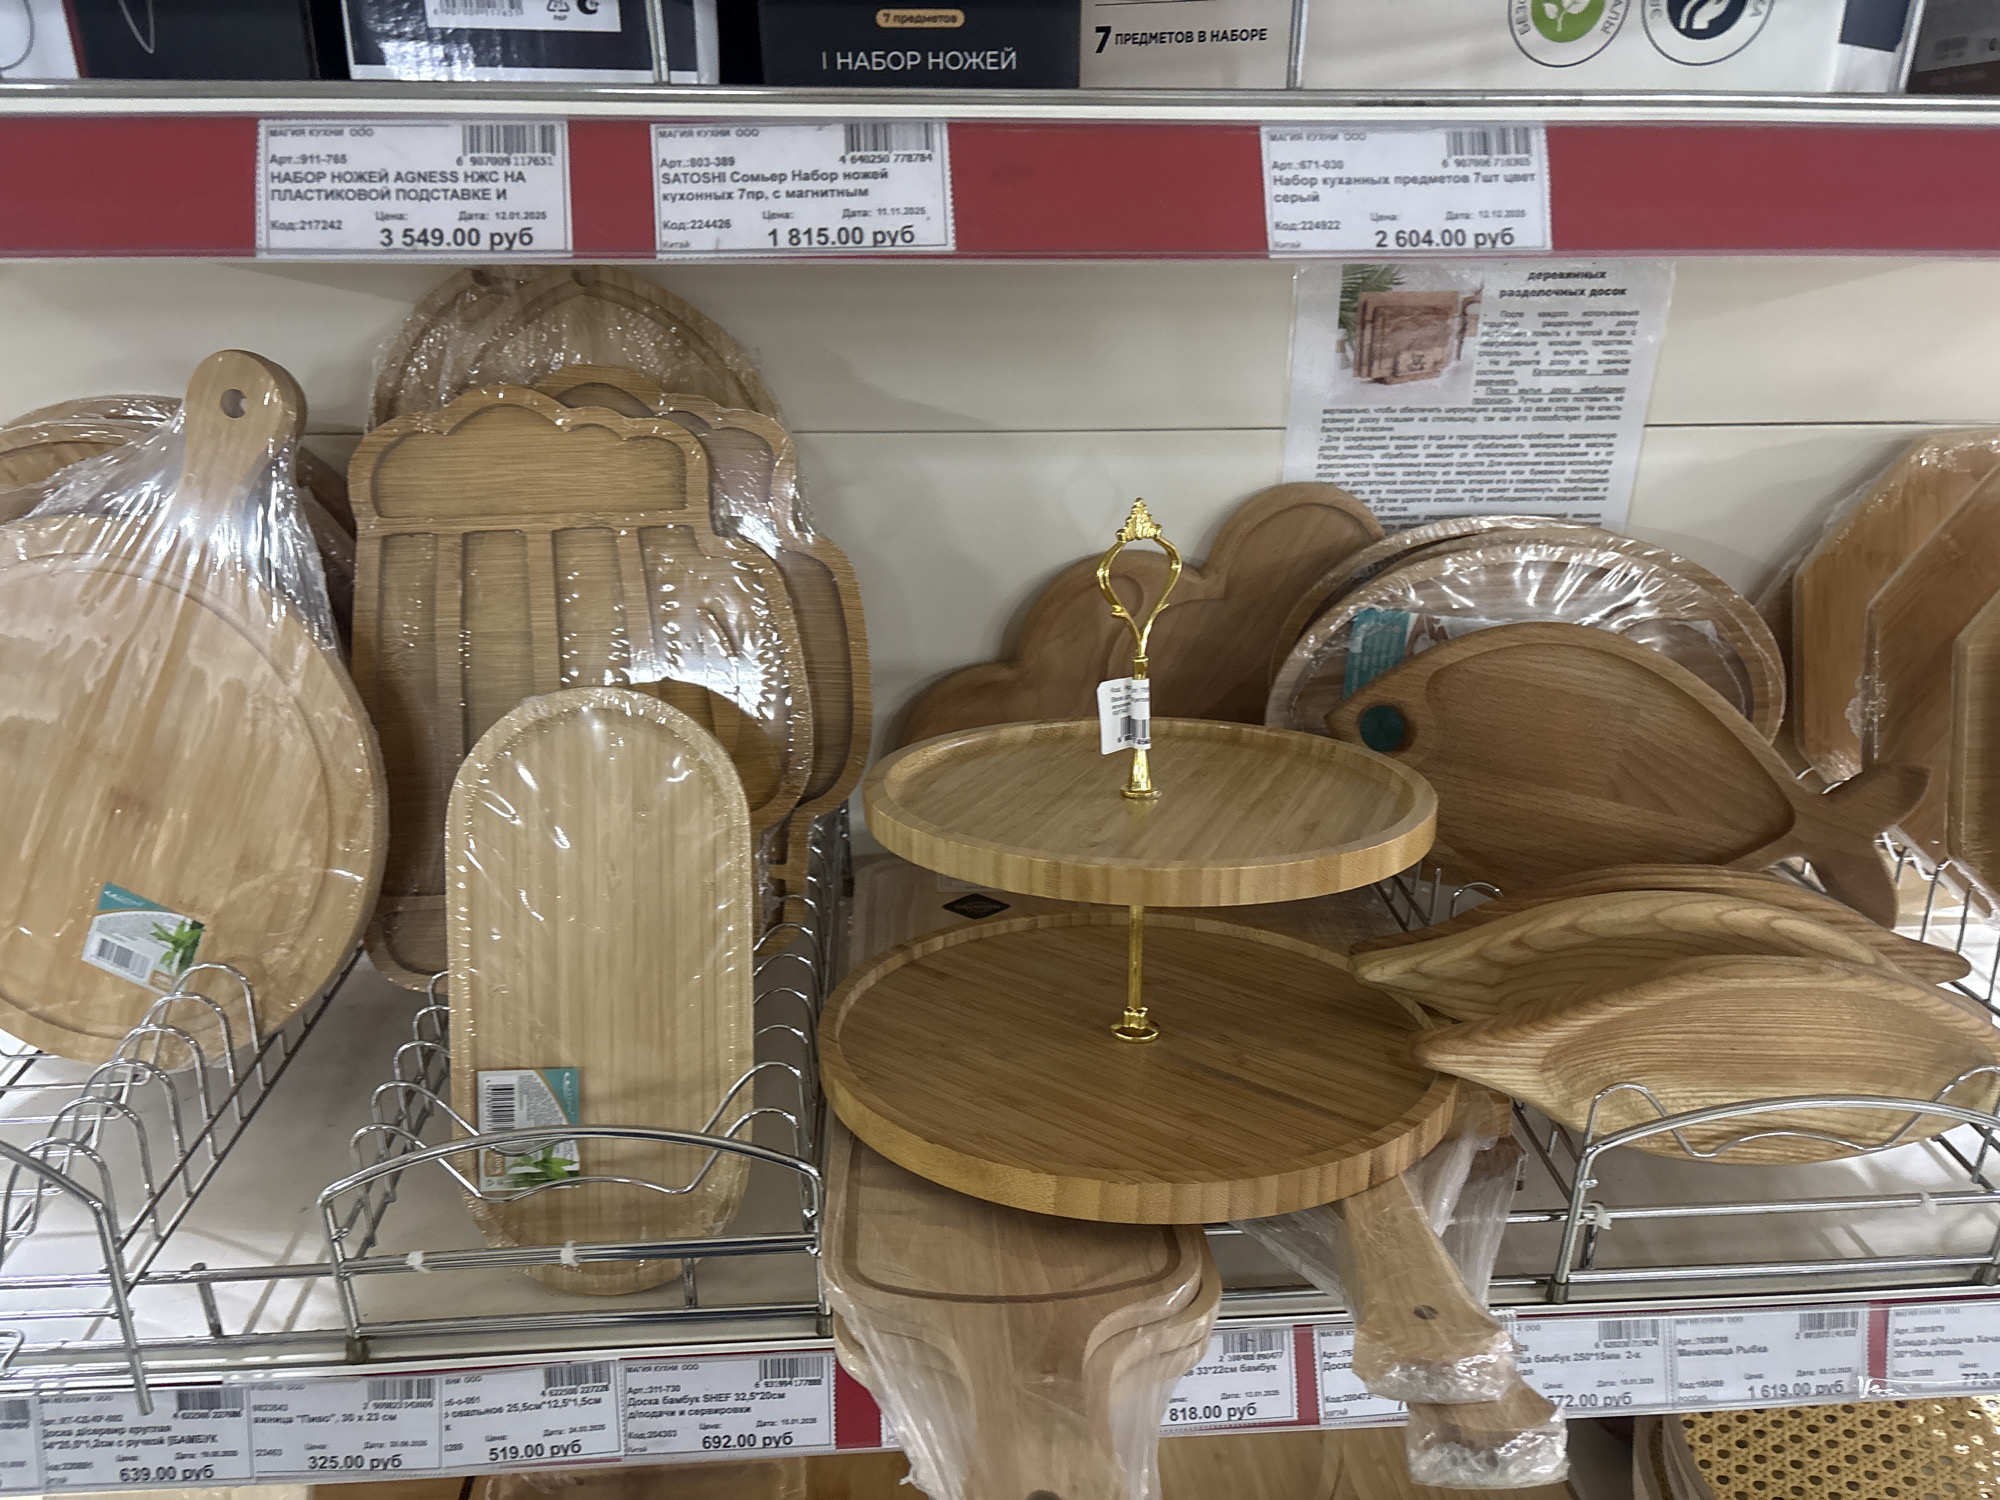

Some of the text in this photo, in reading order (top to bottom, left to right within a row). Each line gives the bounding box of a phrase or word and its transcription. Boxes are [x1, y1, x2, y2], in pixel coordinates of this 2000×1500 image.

[883, 13, 957, 24] 7 предметов
[1095, 26, 1268, 54] 7 ПРЕДМЕТОВ В НАБОРЕ
[836, 47, 1017, 70] НАБОР НОЖЕЙ
[349, 128, 374, 137] ООО
[735, 128, 760, 137] ООО
[271, 168, 527, 183] НАБОР НОЖЕЙ AGNESS НЖС НА
[661, 167, 889, 184] SATOSHI Сомьер Набор ножей
[1273, 175, 1319, 188] Набор
[1394, 175, 1470, 187] предметов
[1473, 171, 1500, 183] 7шт
[1503, 173, 1536, 184] цвет
[271, 187, 507, 202] ПЛАСТИКОВОЙ ПОДСТАВКЕ И
[662, 190, 734, 203] кухонных
[772, 190, 781, 199] с
[785, 188, 870, 199] магнитным
[1274, 191, 1320, 204] серый
[375, 211, 408, 221] Цена:
[458, 210, 490, 221] Дата:
[762, 210, 793, 221] Цена:
[841, 208, 872, 220] Дата:
[271, 220, 343, 232] Код:217242
[663, 219, 732, 231] Код:224426
[380, 227, 534, 250] 3 549.00 руб
[768, 224, 916, 248] 1 815.00 руб
[1375, 227, 1515, 249] 2 604.00 руб
[1528, 271, 1607, 282] деревянных
[1499, 287, 1627, 299] разделочных досок
[1240, 1363, 1277, 1373] бамбук
[1748, 1380, 1843, 1399] 1 619.00 руб
[628, 1397, 659, 1407] Доска
[662, 1395, 700, 1406] бамбук
[703, 1393, 732, 1403] SHEF
[1603, 1391, 1632, 1407] руб
[451, 1406, 504, 1418] овальное
[628, 1407, 751, 1420] д/подачи и сервировки
[1169, 1402, 1257, 1421] 818.00 руб
[702, 1432, 793, 1449] 692.00 руб
[489, 1439, 582, 1461] 519.00 руб
[308, 1454, 403, 1471] 325.00 руб
[120, 1464, 214, 1481] 639.00 руб
